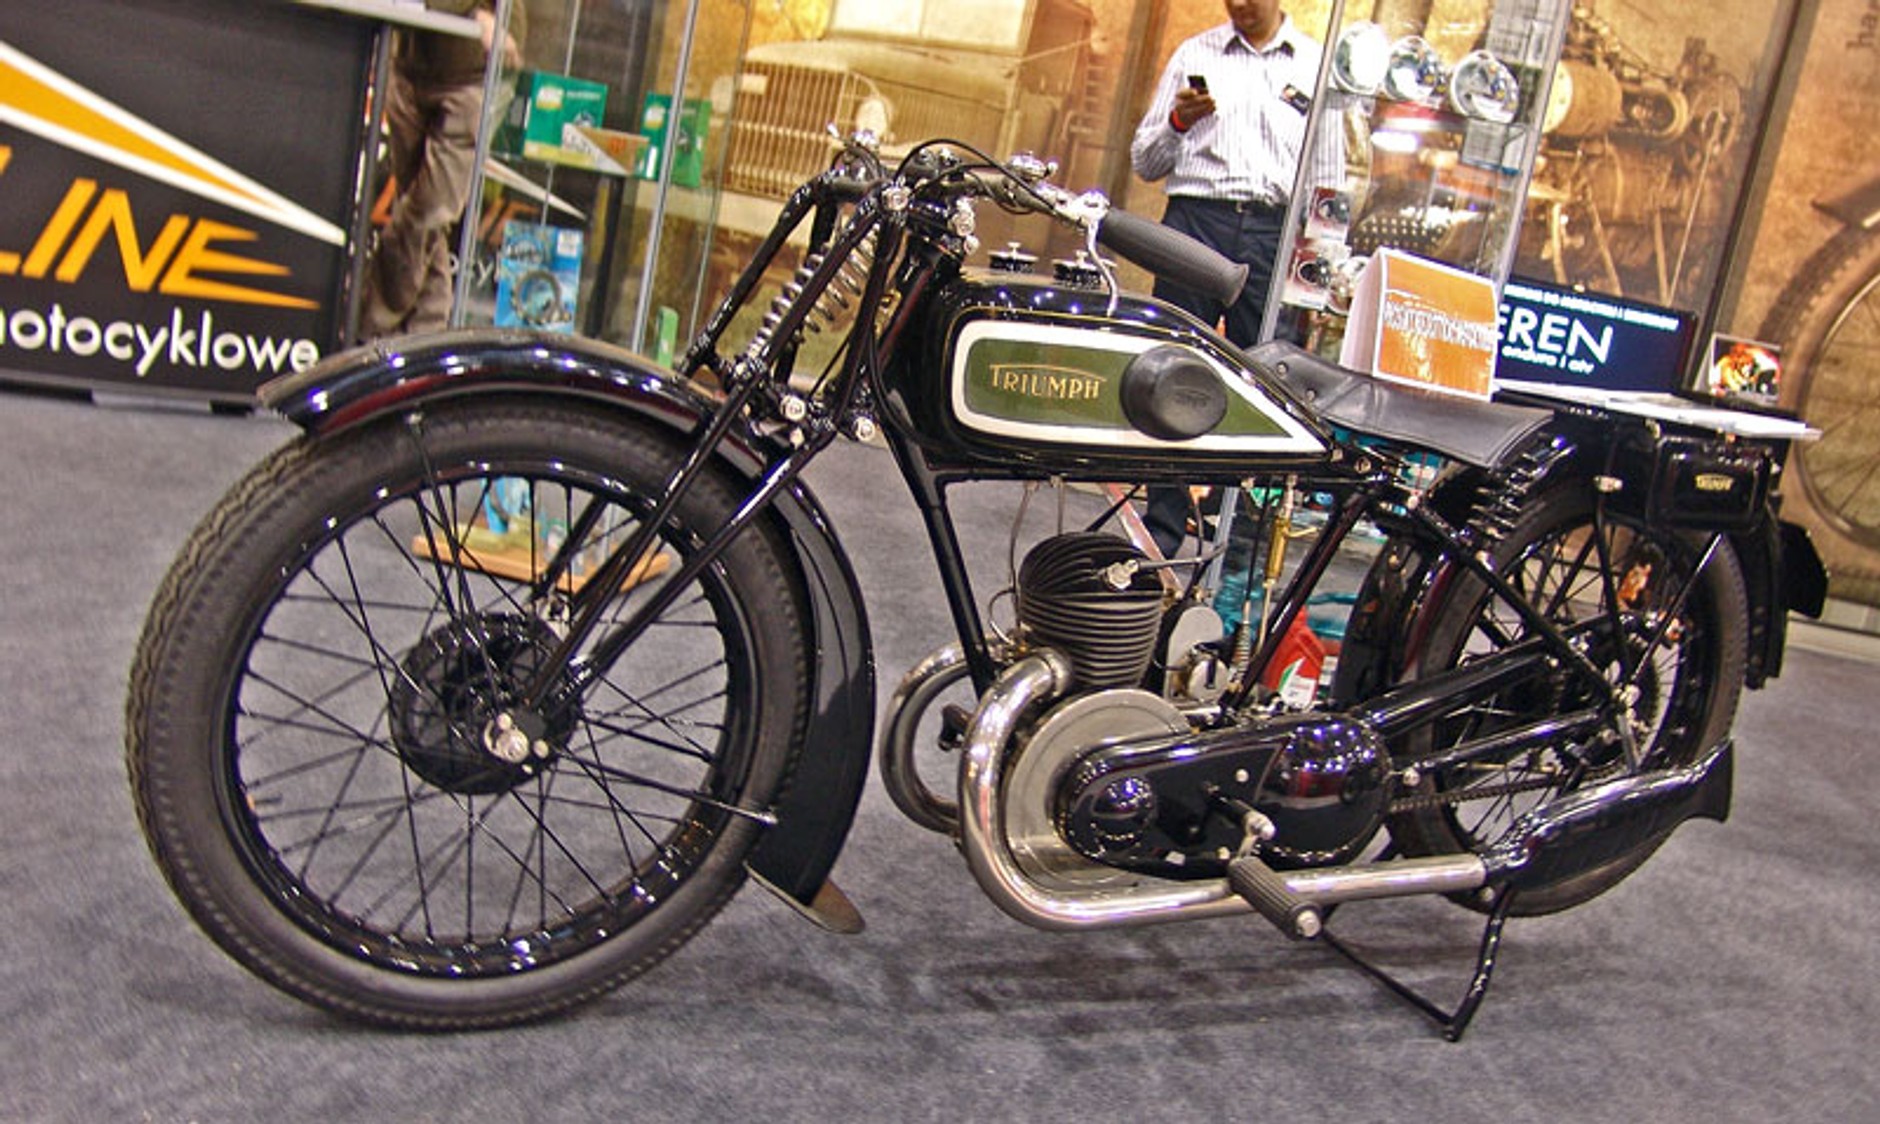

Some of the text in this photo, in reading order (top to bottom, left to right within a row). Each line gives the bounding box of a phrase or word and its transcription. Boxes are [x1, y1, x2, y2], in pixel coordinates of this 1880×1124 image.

[0, 146, 320, 310] INE
[0, 303, 320, 377] otocyklowe
[989, 364, 1103, 400] TRIUMPH
